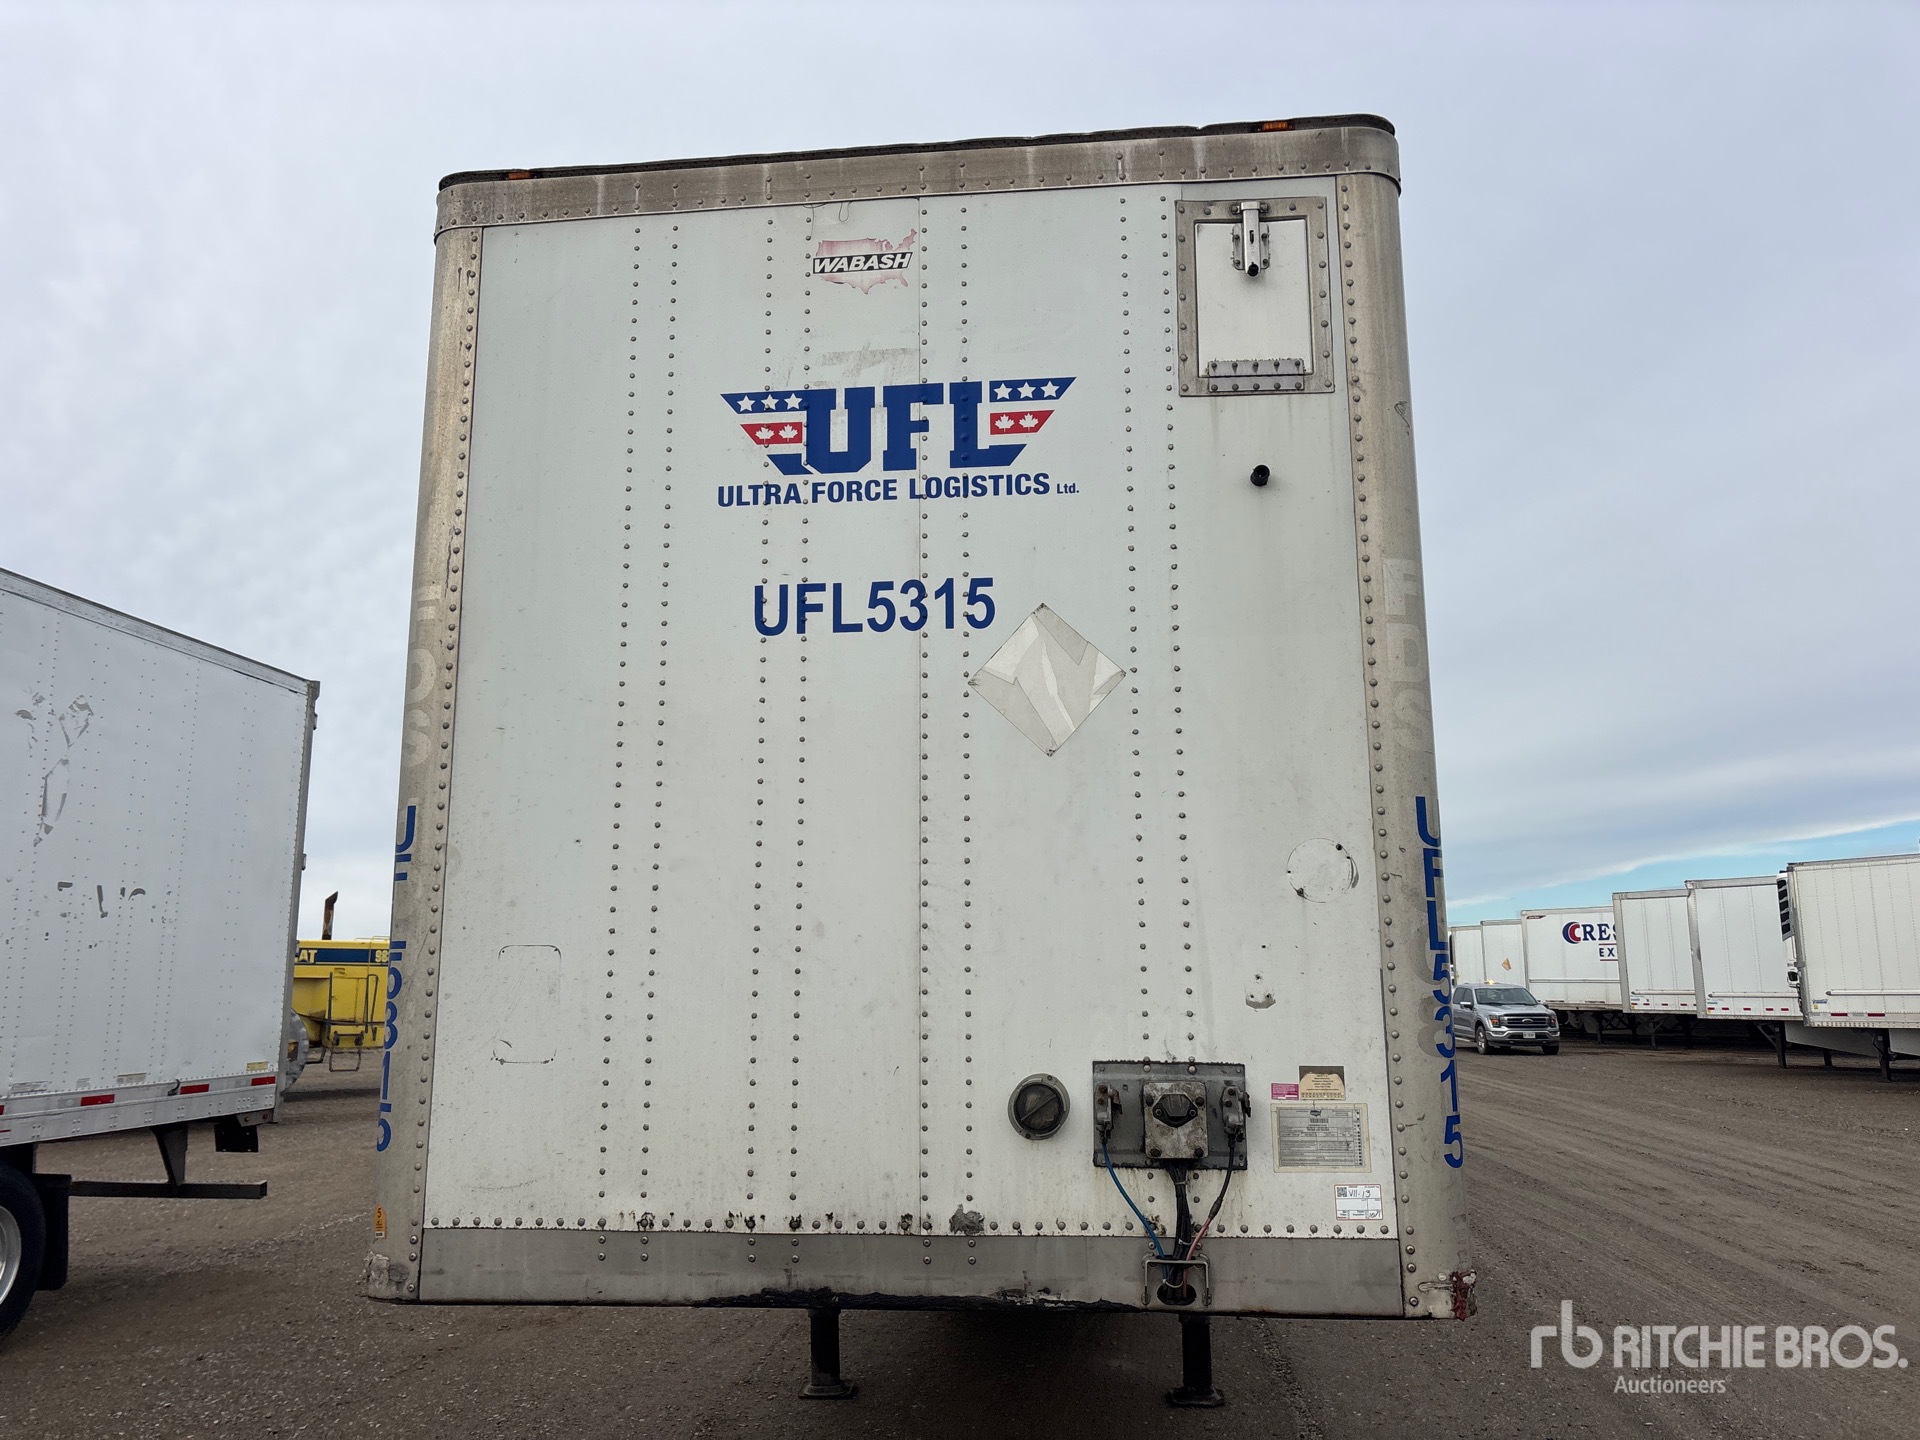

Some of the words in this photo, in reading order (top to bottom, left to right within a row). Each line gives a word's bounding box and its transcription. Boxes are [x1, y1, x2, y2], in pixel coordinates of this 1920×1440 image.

[814, 253, 912, 273] WABASH
[803, 380, 1027, 475] UFL
[718, 483, 801, 507] ULTRA
[811, 479, 898, 504] FORCE
[909, 473, 1050, 500] LOGISTICS
[1057, 483, 1080, 495] Ltd.
[754, 577, 996, 636] UFL5315
[295, 949, 318, 964] AT
